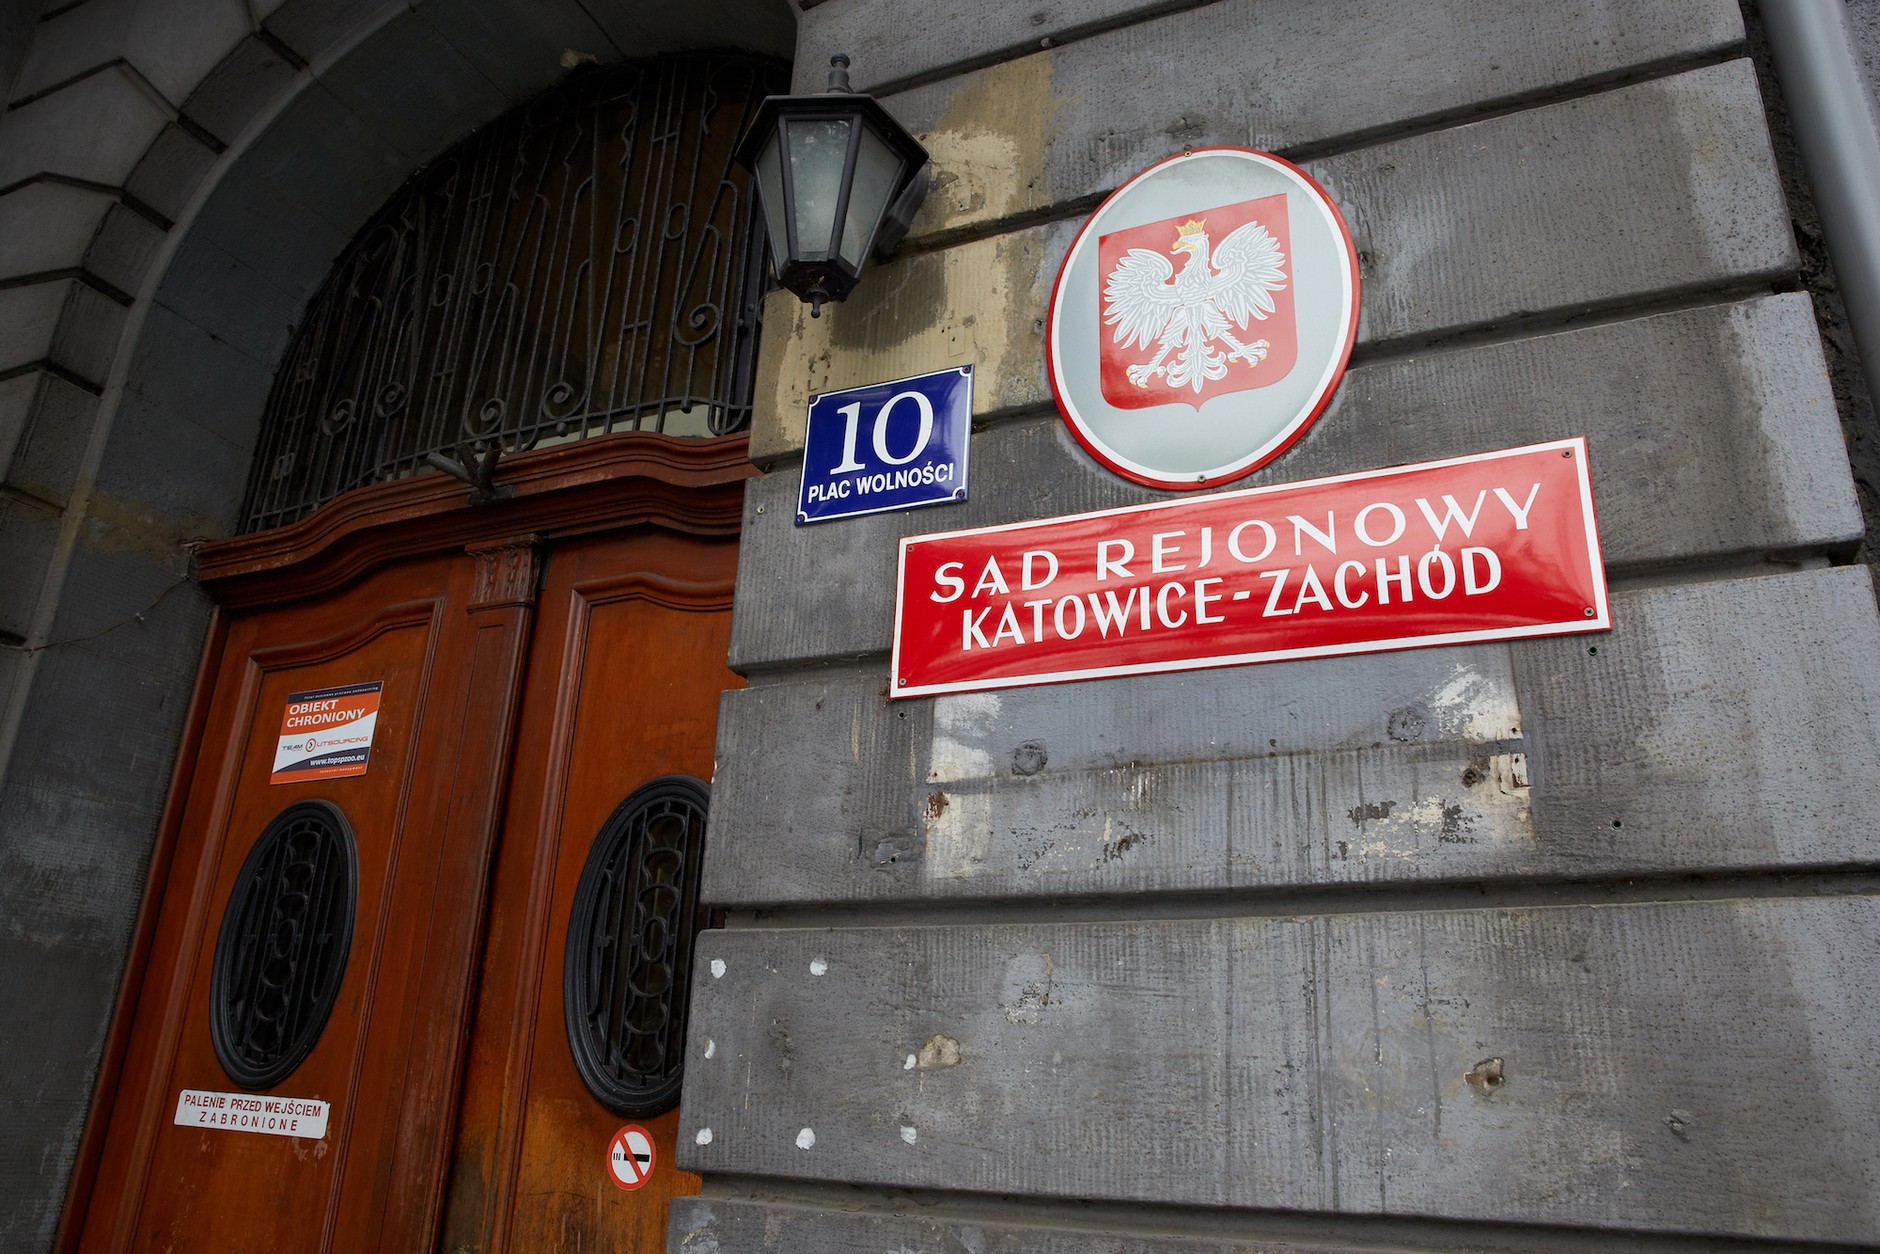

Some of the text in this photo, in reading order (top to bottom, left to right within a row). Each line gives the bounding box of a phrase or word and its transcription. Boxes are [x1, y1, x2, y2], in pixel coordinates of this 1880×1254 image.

[830, 391, 934, 475] 10
[808, 461, 954, 503] PLAC WOLNOŚCI
[930, 483, 1541, 603] SĄD REJONOWY
[289, 699, 339, 715] OBIEKT
[286, 708, 365, 728] CHRONIONY
[310, 754, 365, 766] www.topspzoo.eu
[184, 1094, 322, 1117] PALENIE PRZED WEJŚCIEM
[199, 1111, 298, 1131] ZABRONIONE
